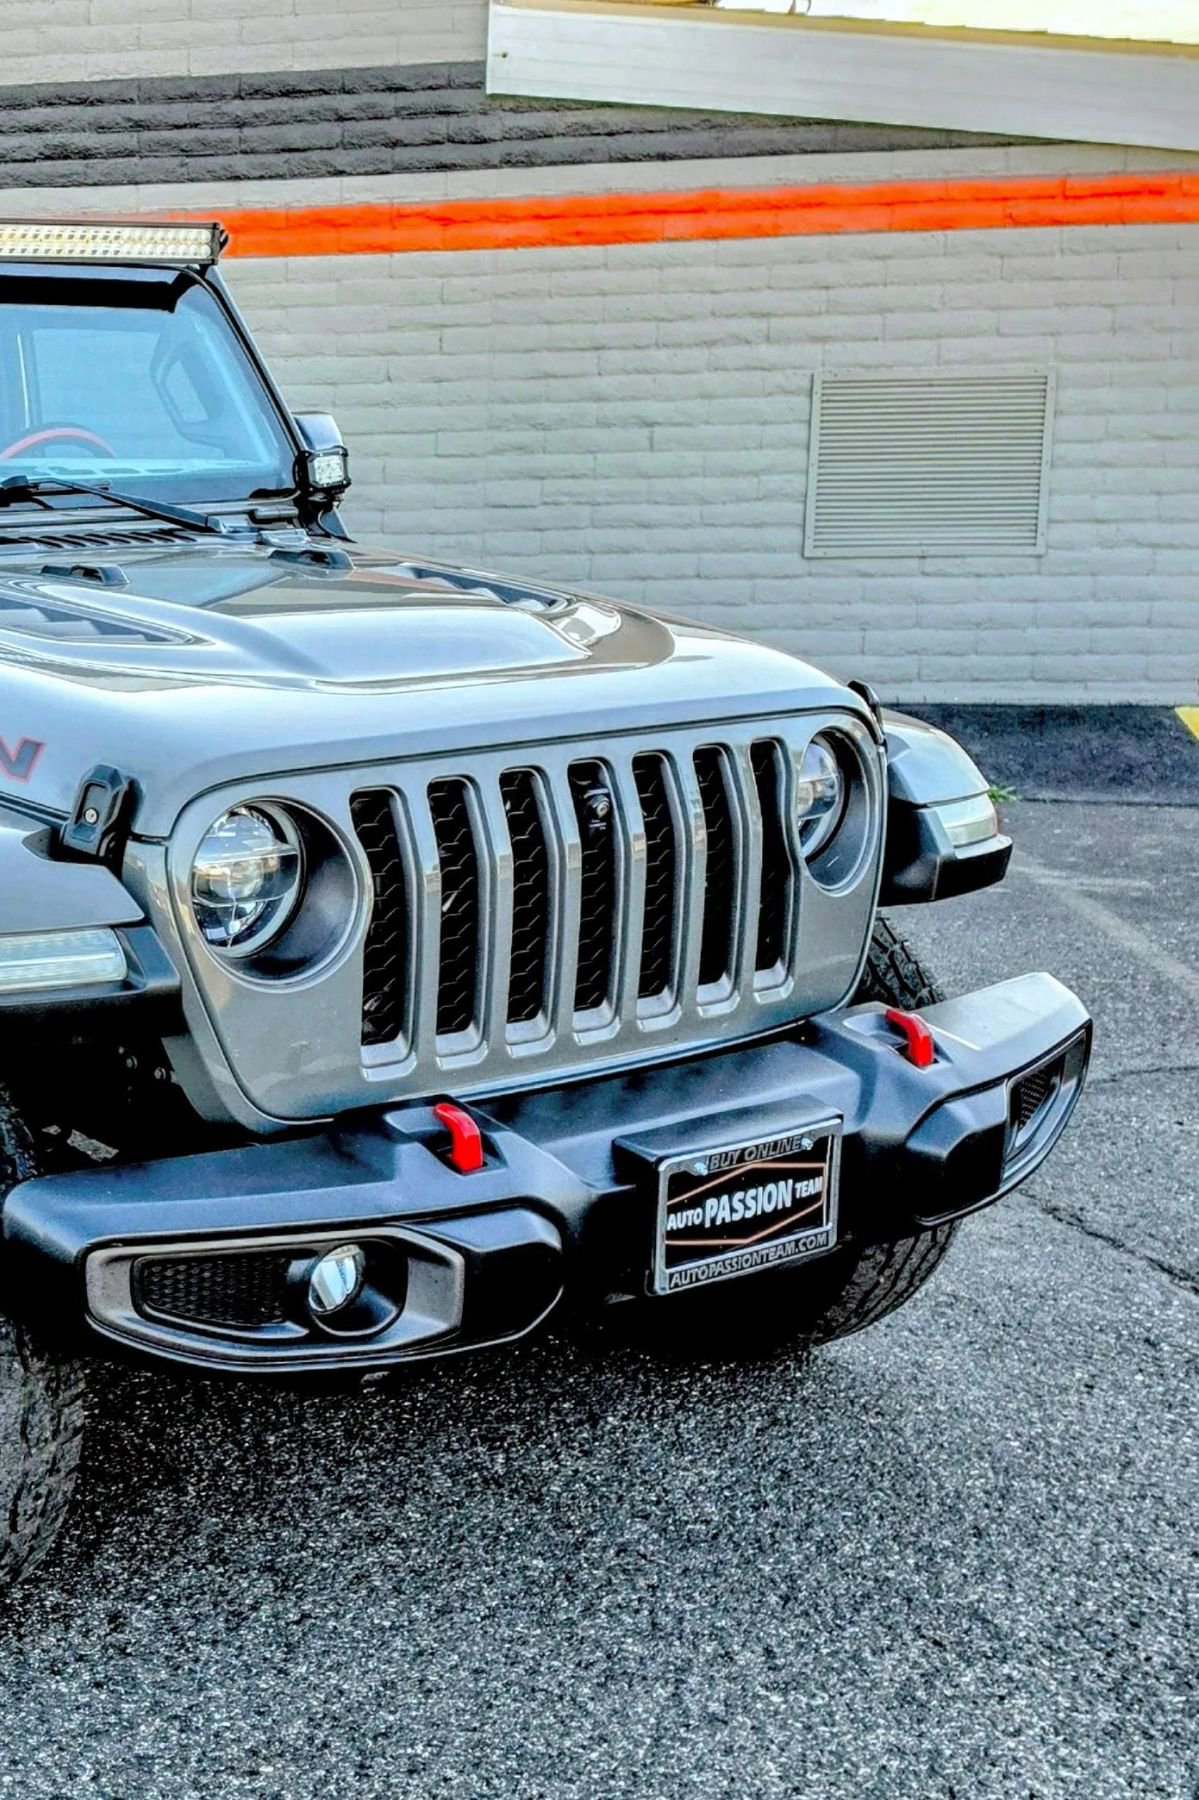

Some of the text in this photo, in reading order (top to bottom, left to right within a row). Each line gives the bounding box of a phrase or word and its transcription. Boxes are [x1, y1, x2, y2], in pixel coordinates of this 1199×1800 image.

[710, 1136, 800, 1170] BUY ONLINE
[667, 1176, 823, 1230] AUTO PASSION TEAM
[670, 1231, 828, 1288] AUTOPASSIONTEAM.COM
